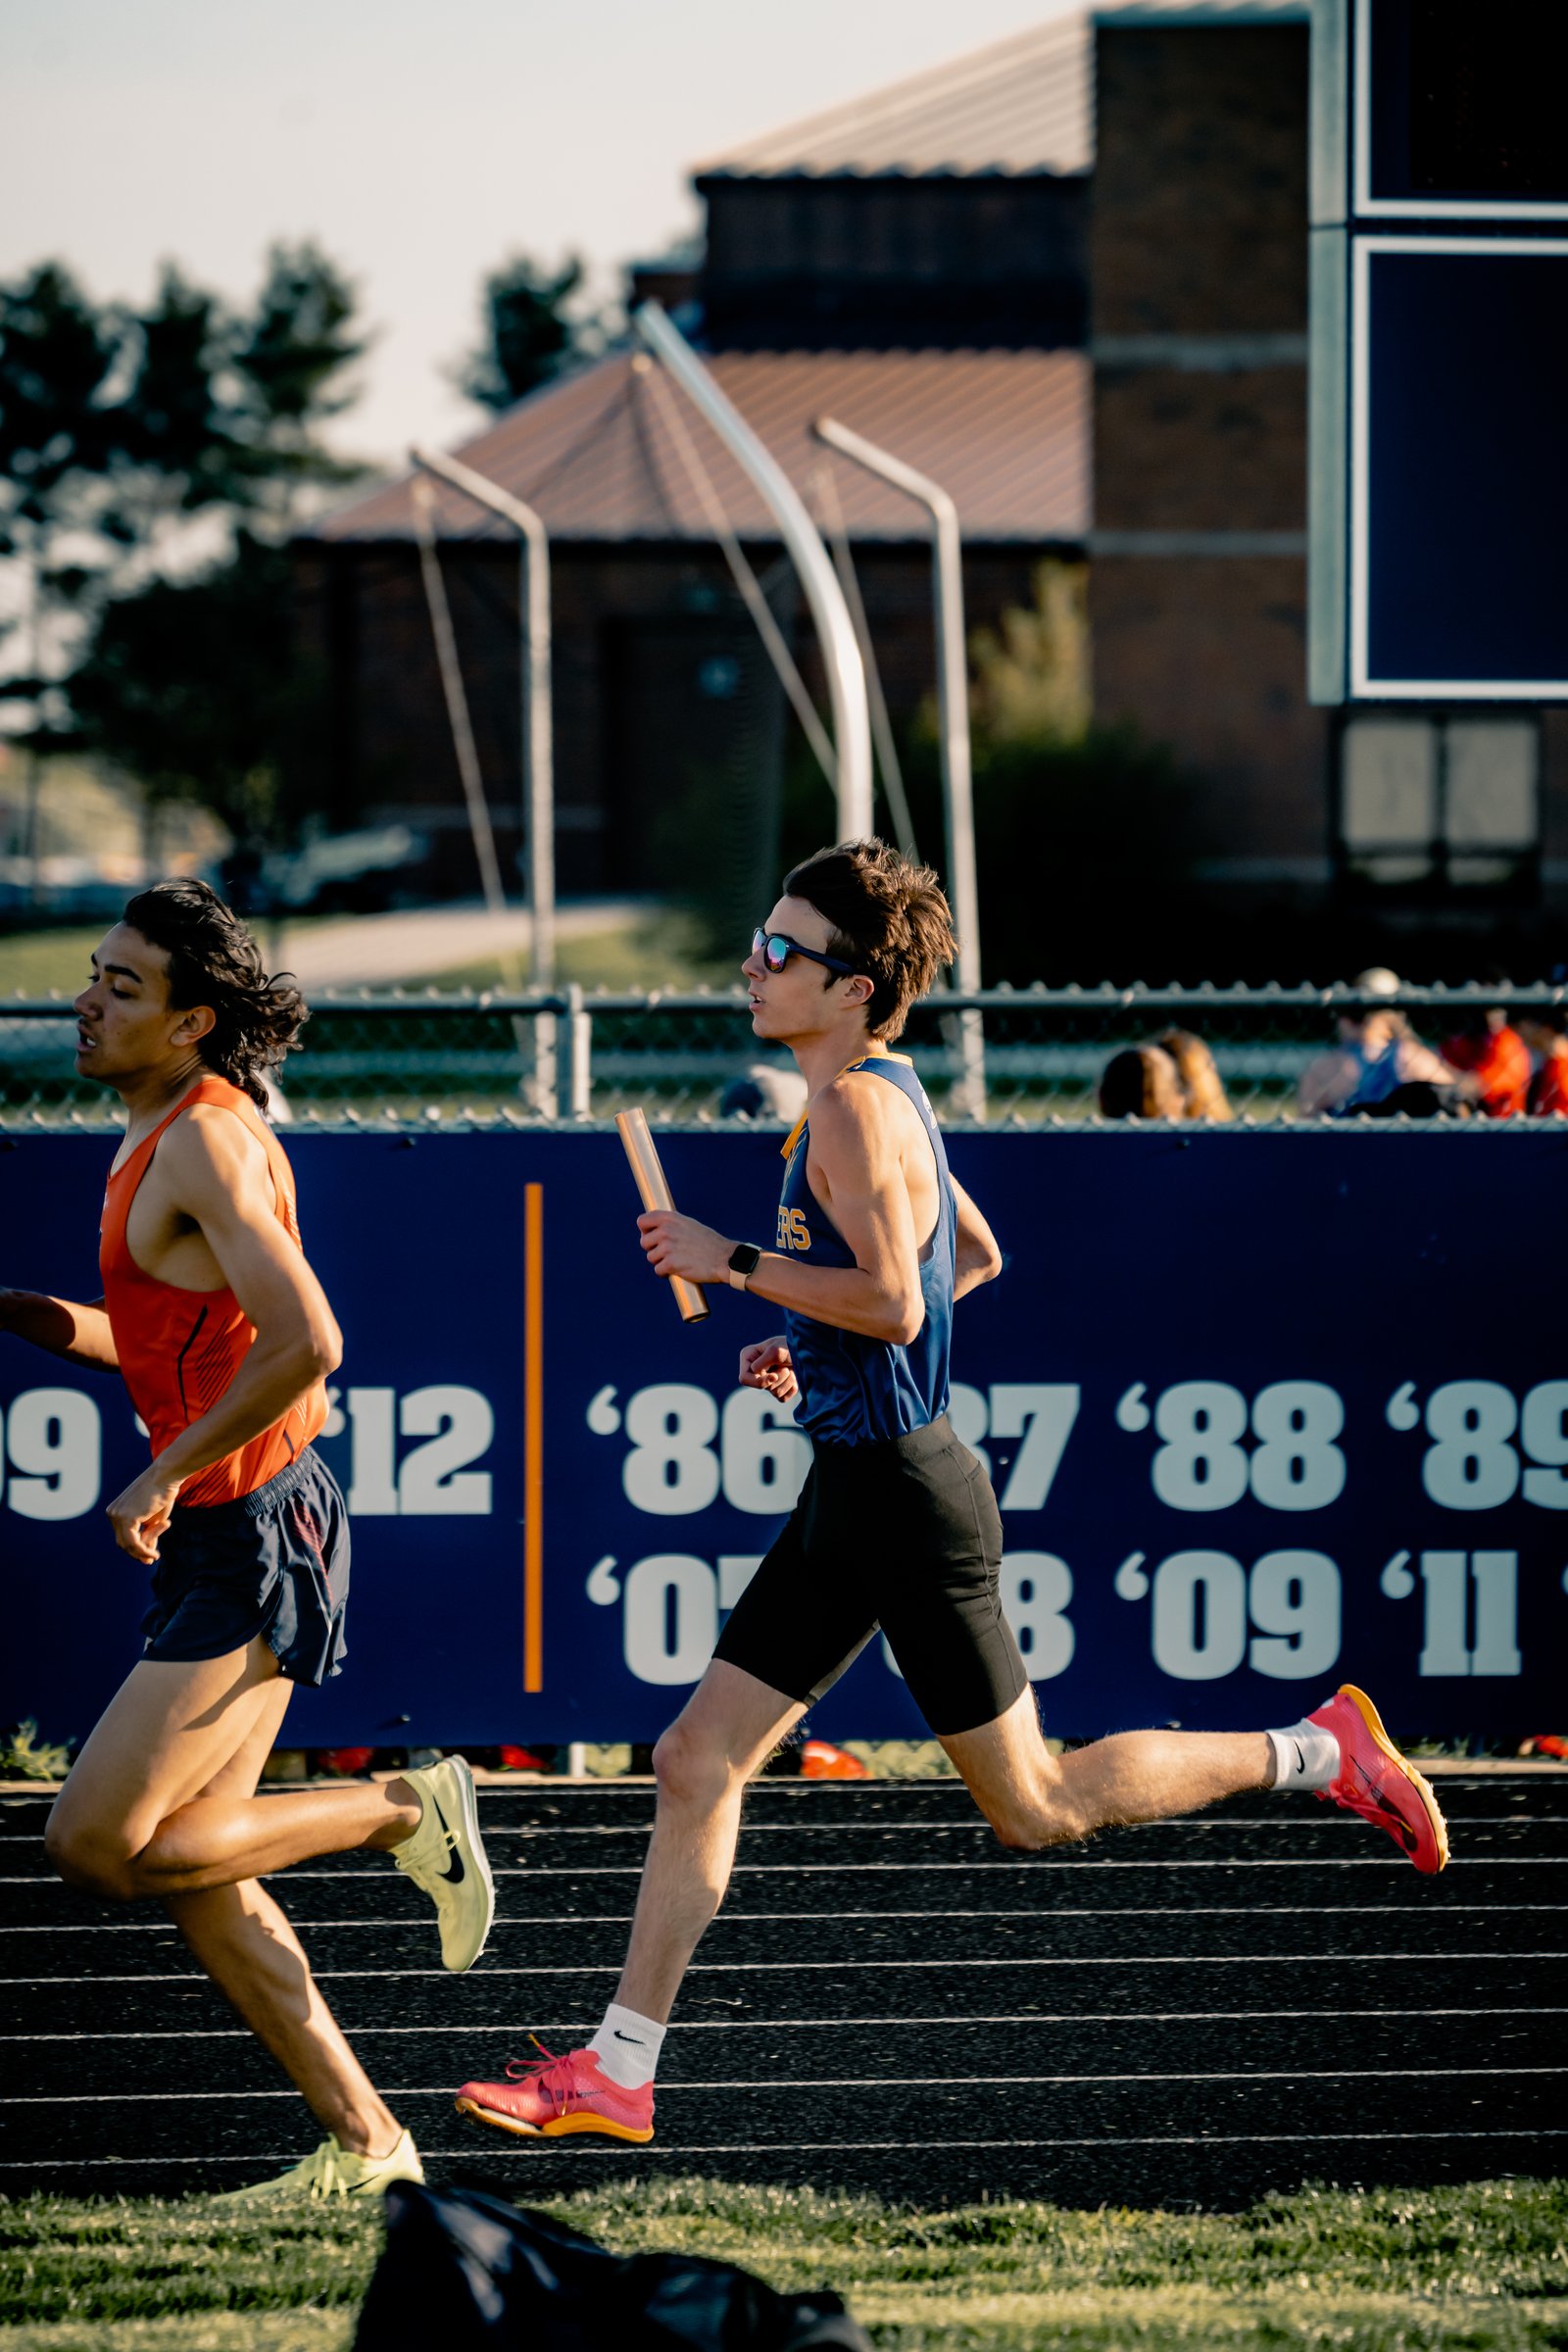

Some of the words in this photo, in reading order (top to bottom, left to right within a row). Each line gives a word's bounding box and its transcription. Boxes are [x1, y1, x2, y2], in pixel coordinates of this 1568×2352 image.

[0, 1387, 101, 1521] 9
[586, 1383, 814, 1515] ‘86
[1116, 1380, 1347, 1511] ‘88
[1114, 1548, 1343, 1681] ‘09
[1380, 1549, 1521, 1677] ‘11
